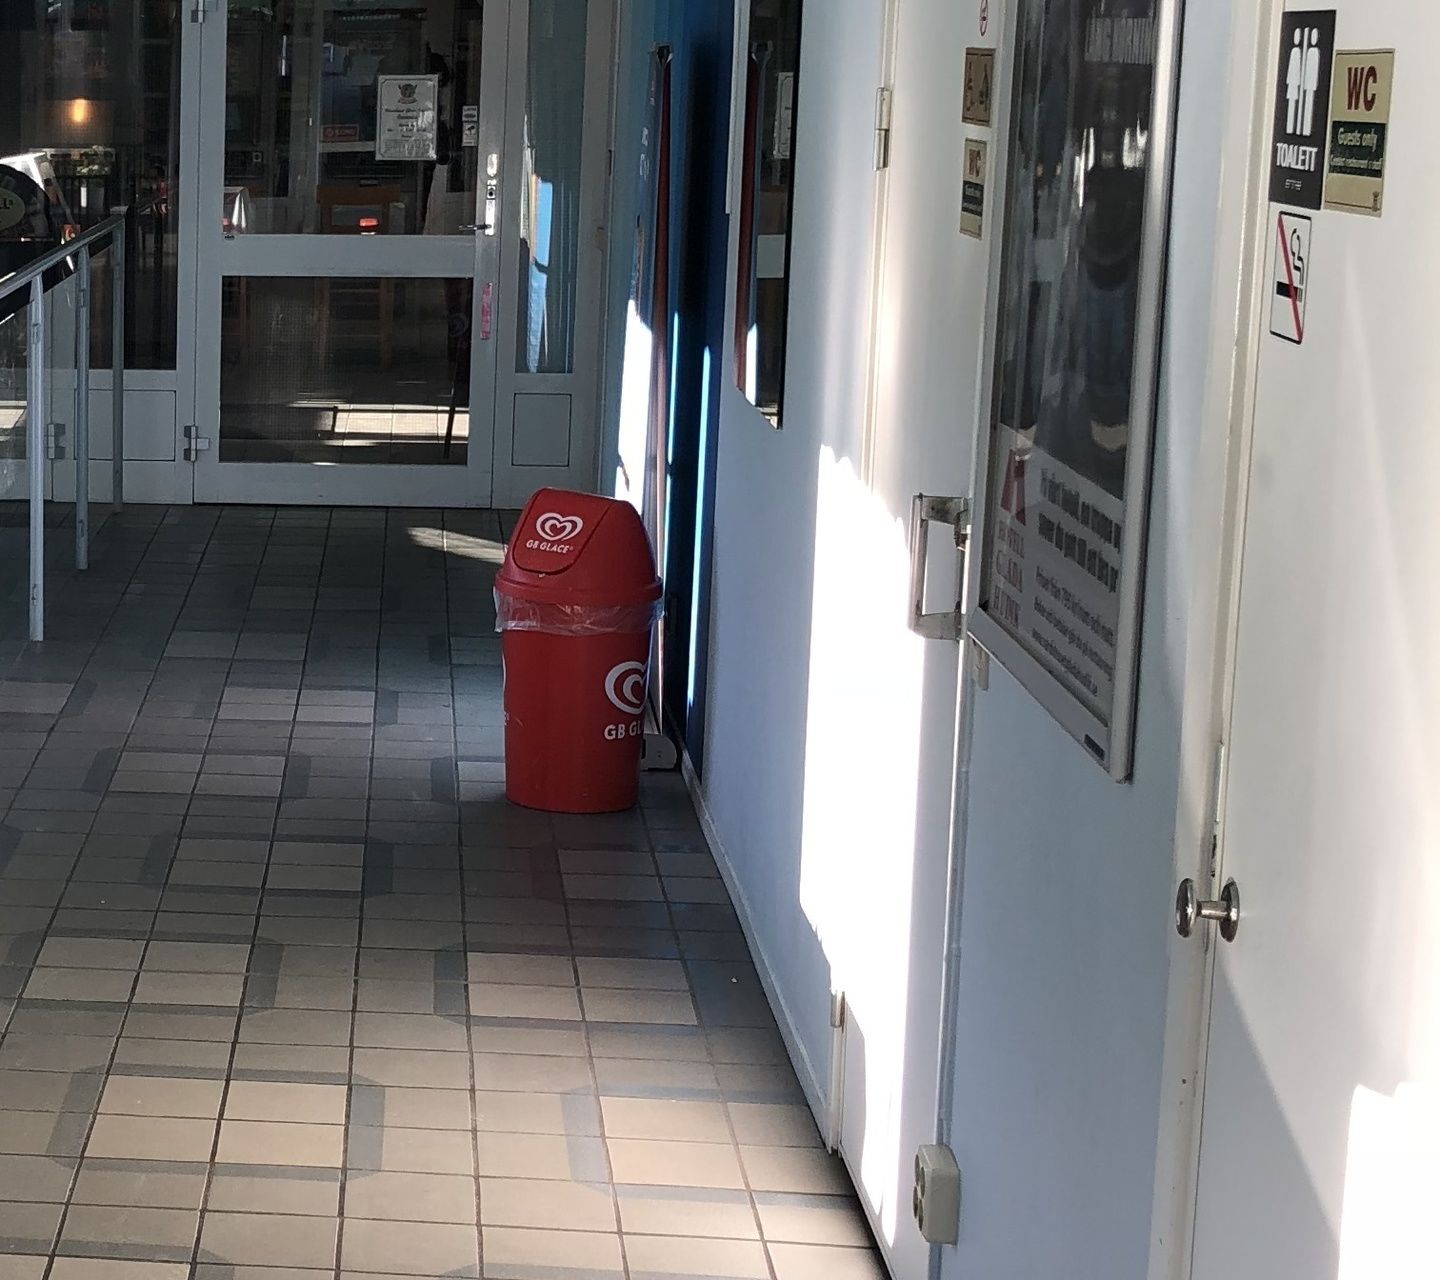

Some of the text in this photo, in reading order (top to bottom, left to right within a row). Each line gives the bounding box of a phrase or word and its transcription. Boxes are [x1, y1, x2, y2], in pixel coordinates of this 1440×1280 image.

[1346, 65, 1378, 112] WC
[1275, 141, 1318, 172] TOALETT
[526, 539, 540, 549] GB
[604, 724, 626, 741] GB
